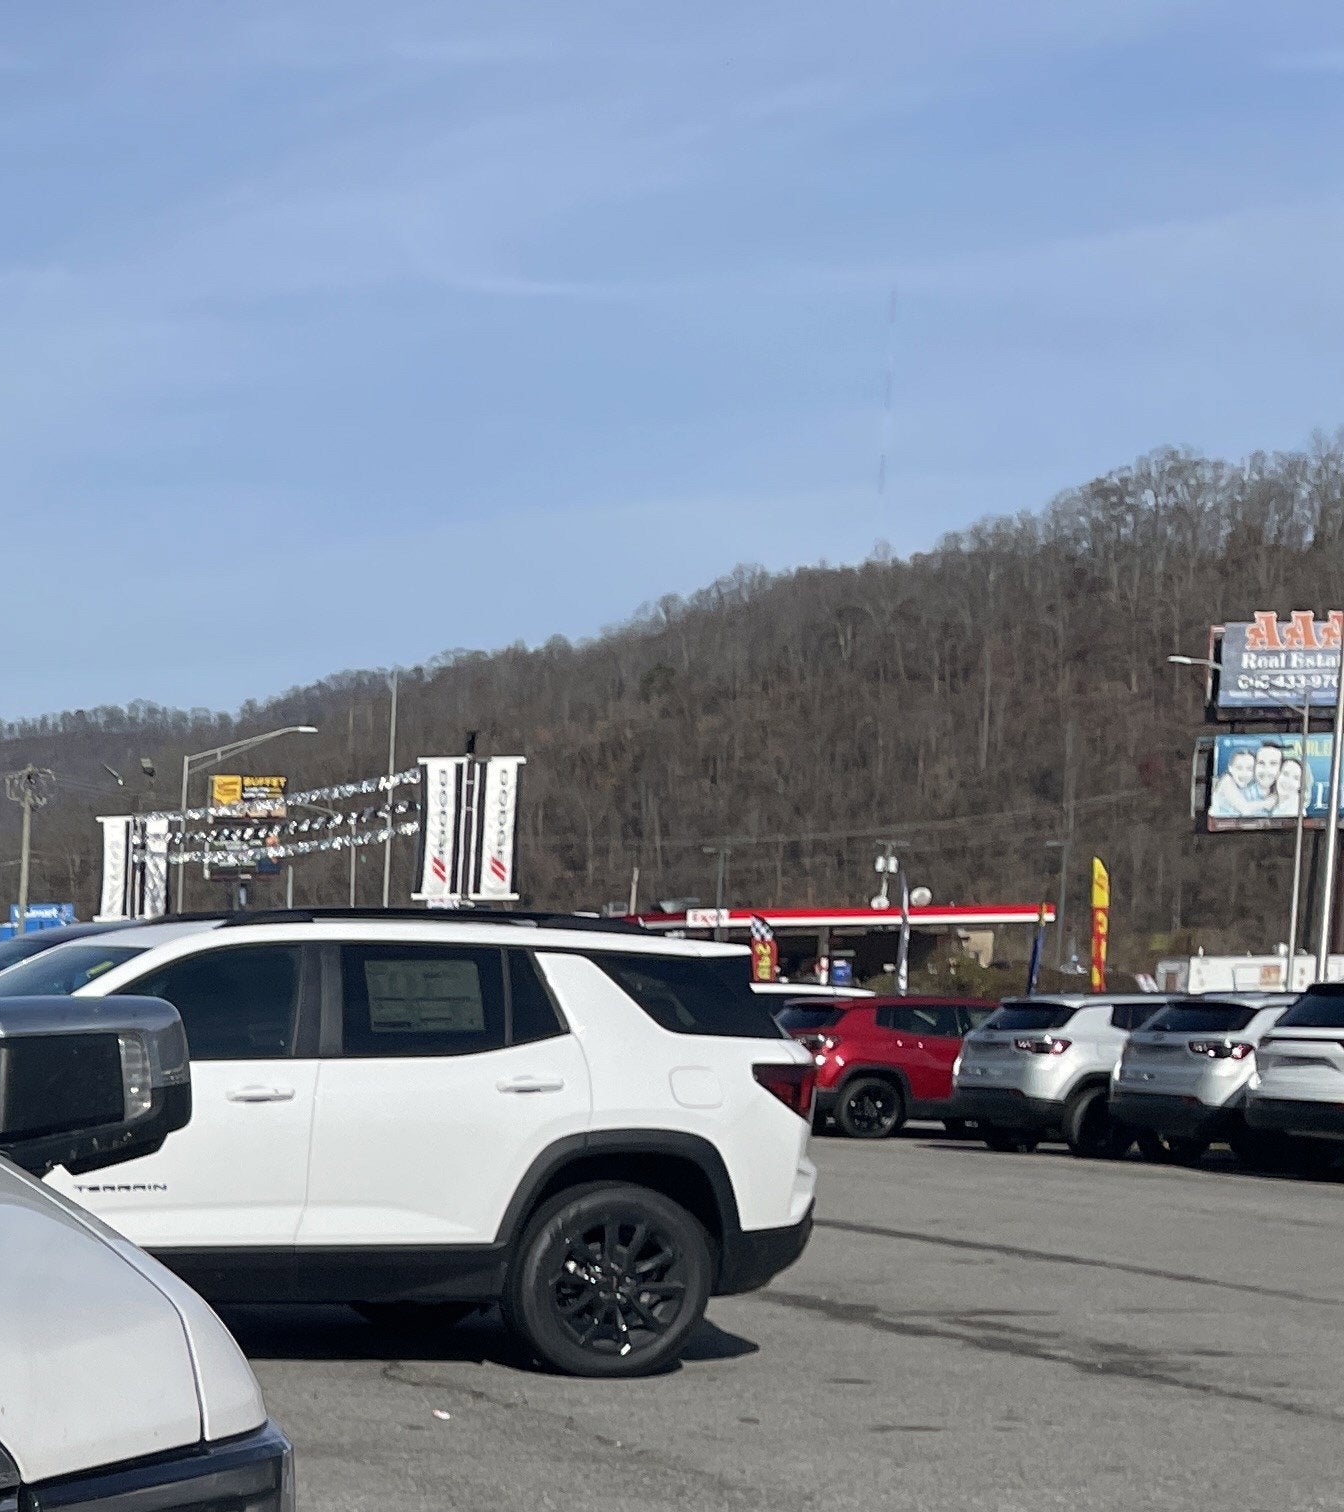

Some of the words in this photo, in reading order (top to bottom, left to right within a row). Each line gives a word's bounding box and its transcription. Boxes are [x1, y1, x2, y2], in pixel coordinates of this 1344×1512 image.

[1241, 652, 1286, 669] Real
[1291, 651, 1340, 669] Esta
[74, 1184, 168, 1192] TERRAIN
